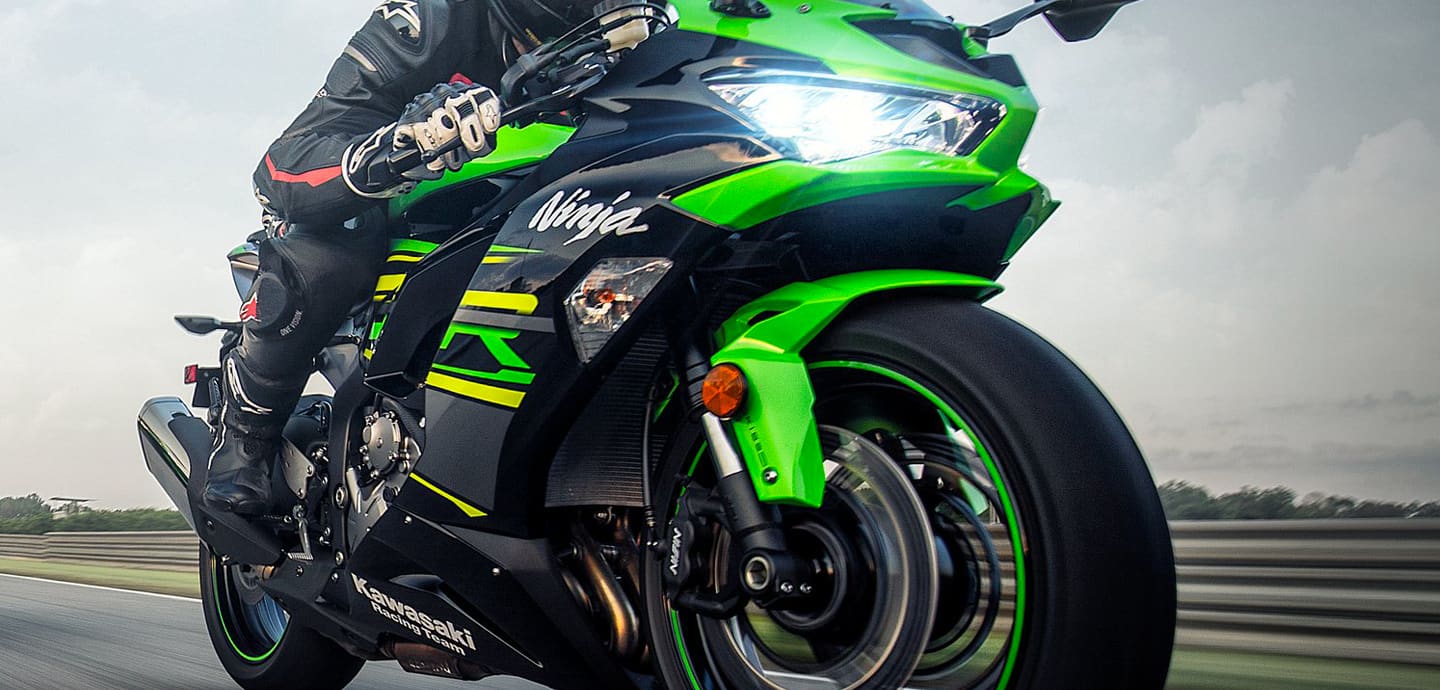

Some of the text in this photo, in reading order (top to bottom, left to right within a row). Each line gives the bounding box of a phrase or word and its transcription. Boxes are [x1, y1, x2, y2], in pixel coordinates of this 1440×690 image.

[527, 187, 649, 246] Ninja
[351, 571, 477, 651] Kawasaki
[371, 601, 466, 656] Racing Team
